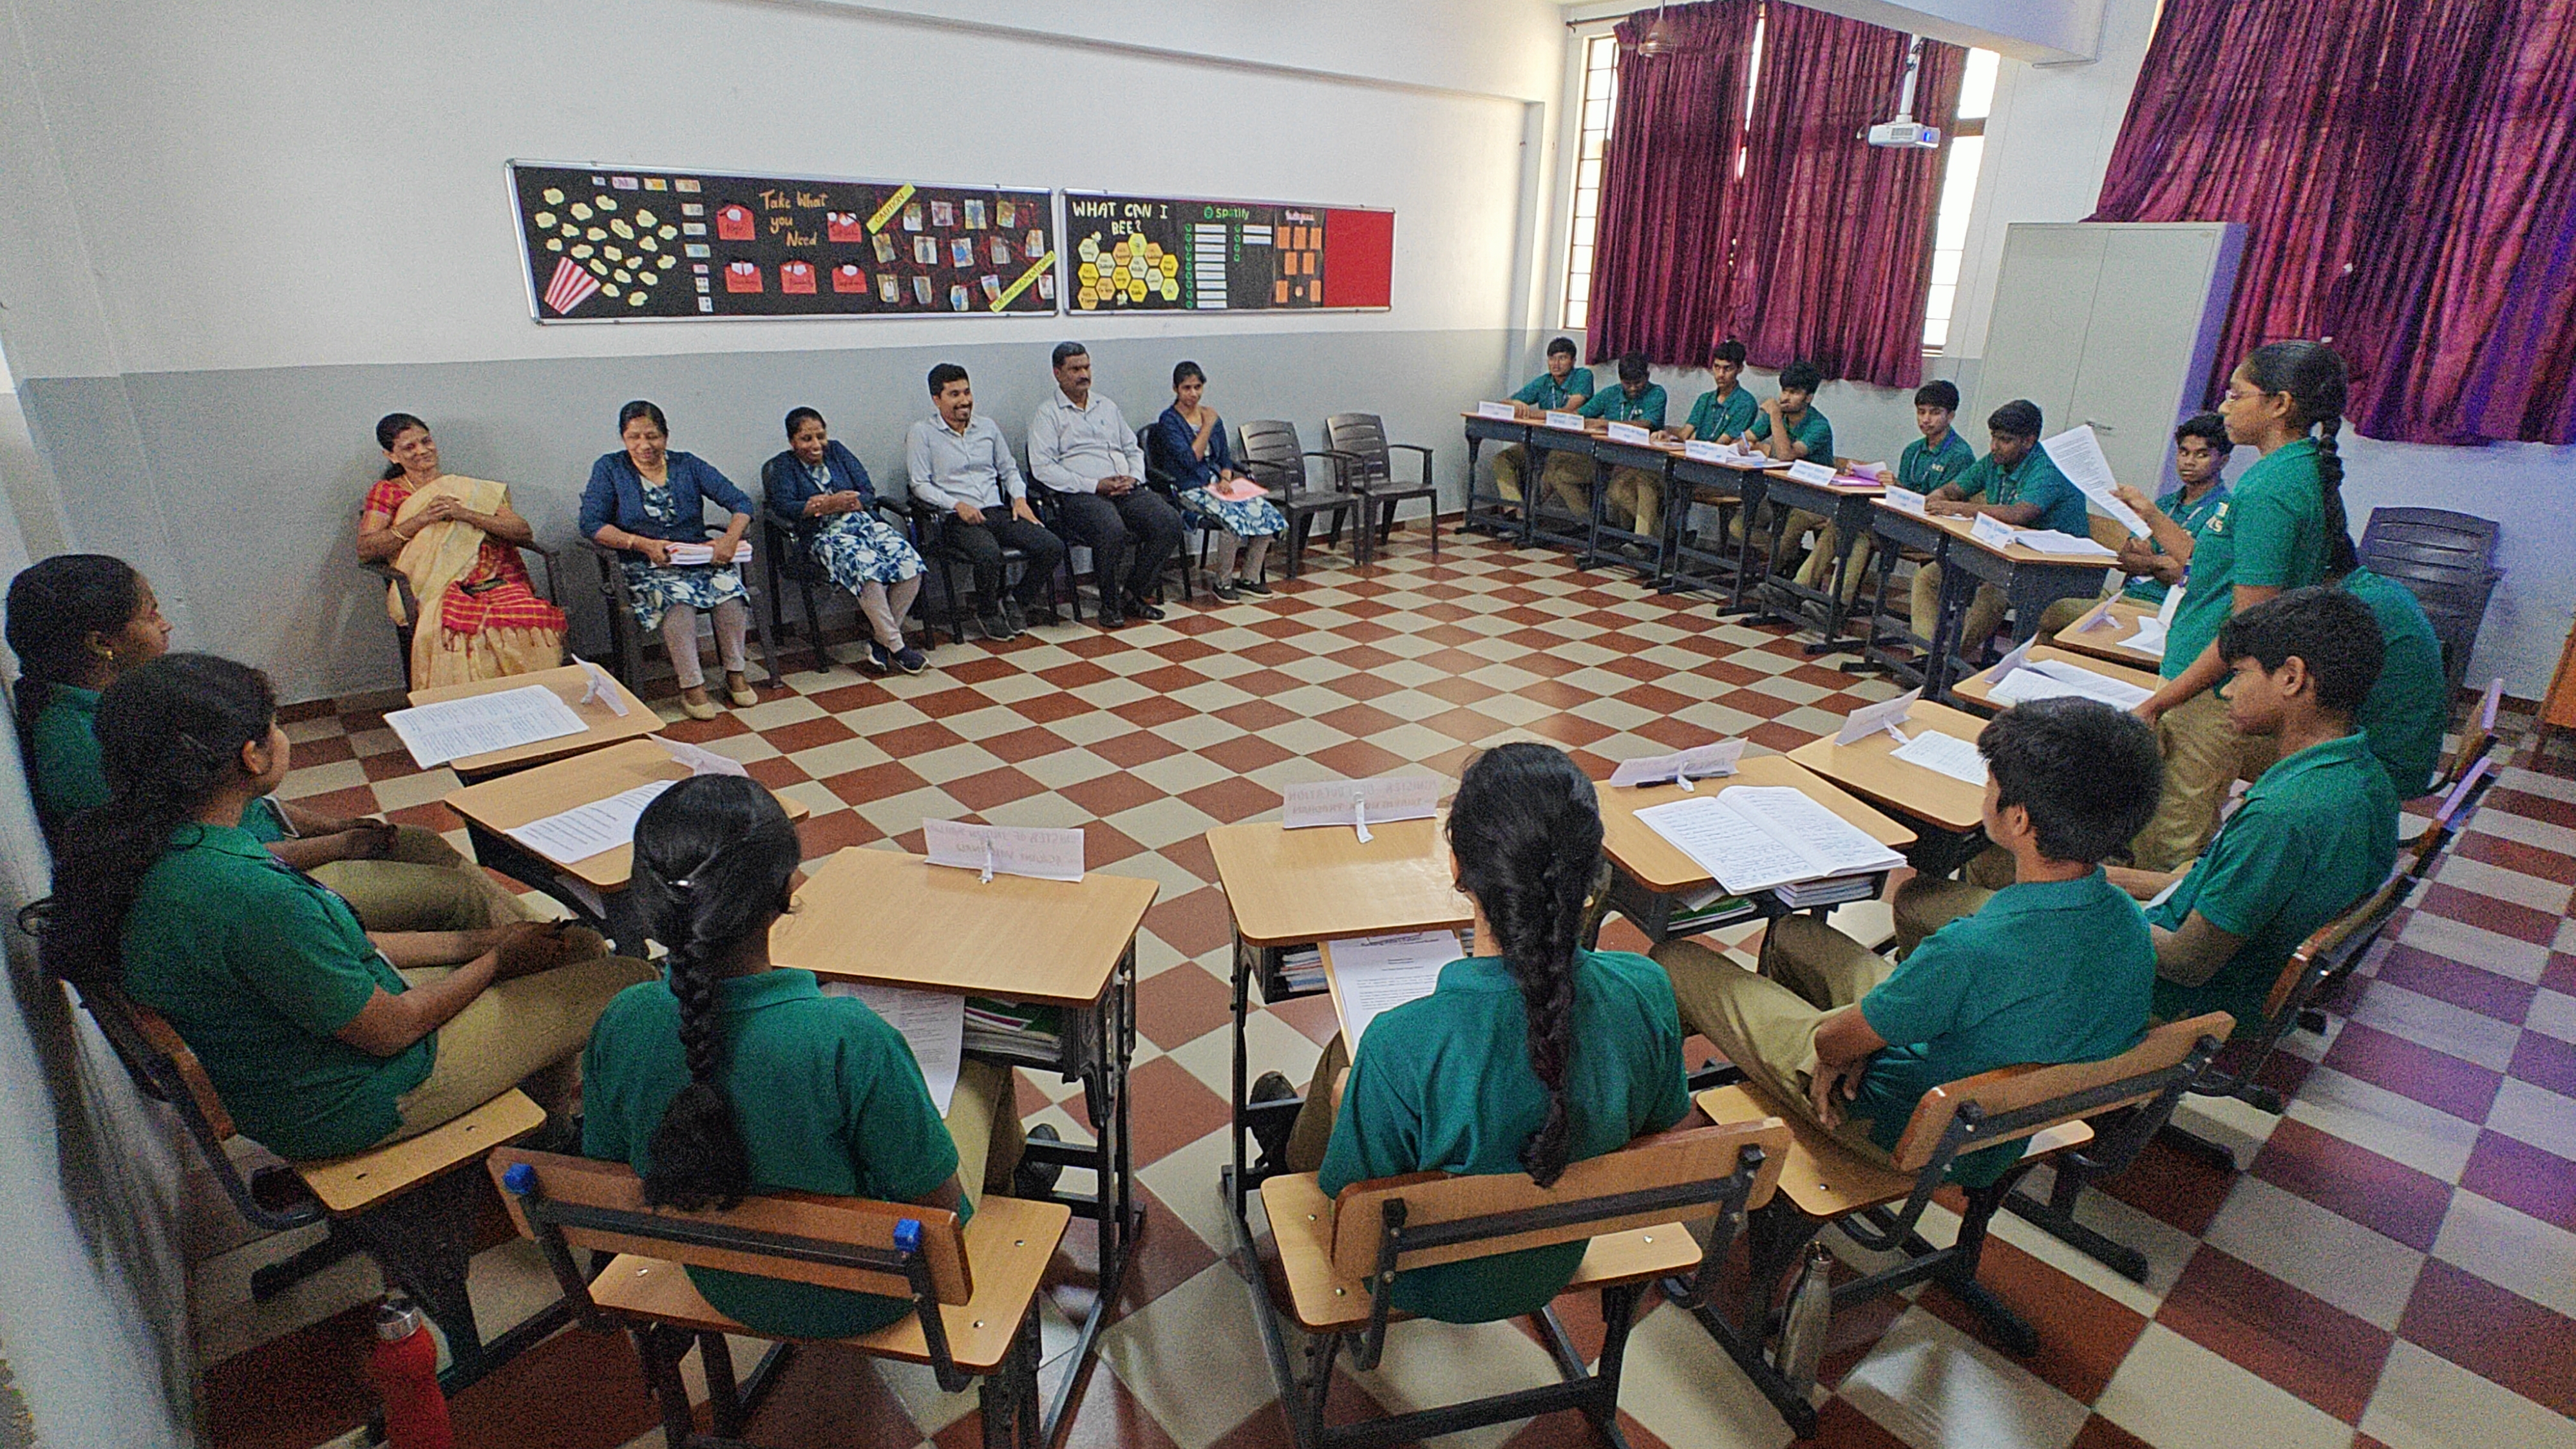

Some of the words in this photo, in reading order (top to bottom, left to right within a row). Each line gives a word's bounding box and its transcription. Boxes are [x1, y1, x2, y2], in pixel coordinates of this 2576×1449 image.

[759, 189, 791, 209] Take
[797, 191, 828, 208] What
[875, 192, 905, 223] CAUTION
[1072, 201, 1117, 218] WHAT
[1124, 203, 1151, 218] CAN
[1160, 204, 1168, 219] I
[770, 216, 793, 234] you
[786, 231, 817, 247] Need
